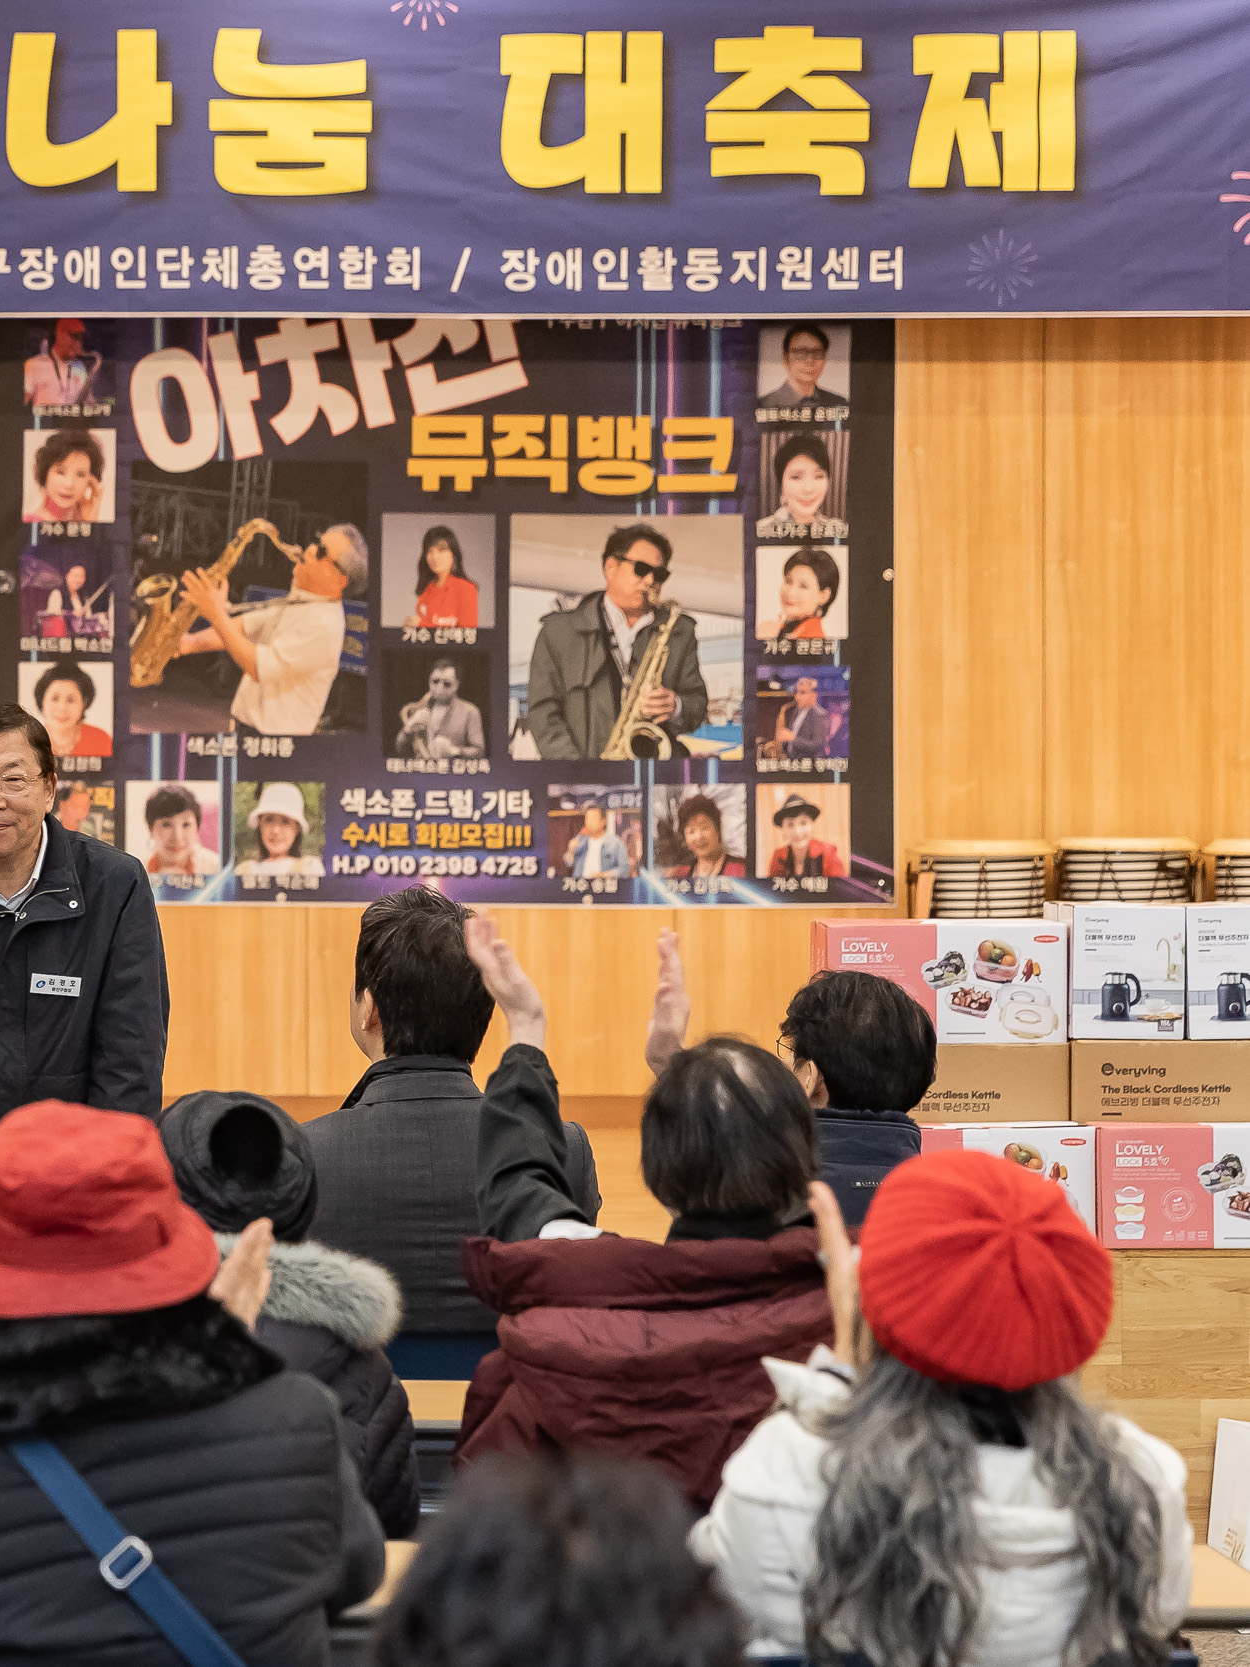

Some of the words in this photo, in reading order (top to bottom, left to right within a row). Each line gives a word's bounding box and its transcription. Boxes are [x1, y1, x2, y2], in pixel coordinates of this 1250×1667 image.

[500, 26, 1078, 197] 대축제
[500, 246, 905, 293] 장애인활동지원센터
[407, 414, 738, 497] 뮤직뱅크
[187, 736, 238, 757] 색소폰
[340, 787, 534, 822] 색소폰,드럼,기타
[342, 821, 411, 849] 수시로
[415, 821, 533, 850] 회원모집!!!
[332, 853, 371, 876] H.P
[373, 854, 417, 876] 010
[841, 940, 889, 953] LOVELY
[923, 1090, 969, 1100] Cordless
[971, 1090, 1002, 1100] Kettle
[1101, 1084, 1121, 1094] The
[1122, 1084, 1151, 1094] Black
[1153, 1084, 1199, 1094] Cordless
[1201, 1084, 1232, 1094] Kettle
[943, 1102, 991, 1113] 무선주전자
[1141, 1096, 1170, 1107] 더블랙
[1172, 1096, 1221, 1107] 무선주전자
[1115, 1142, 1165, 1156] LOVELY
